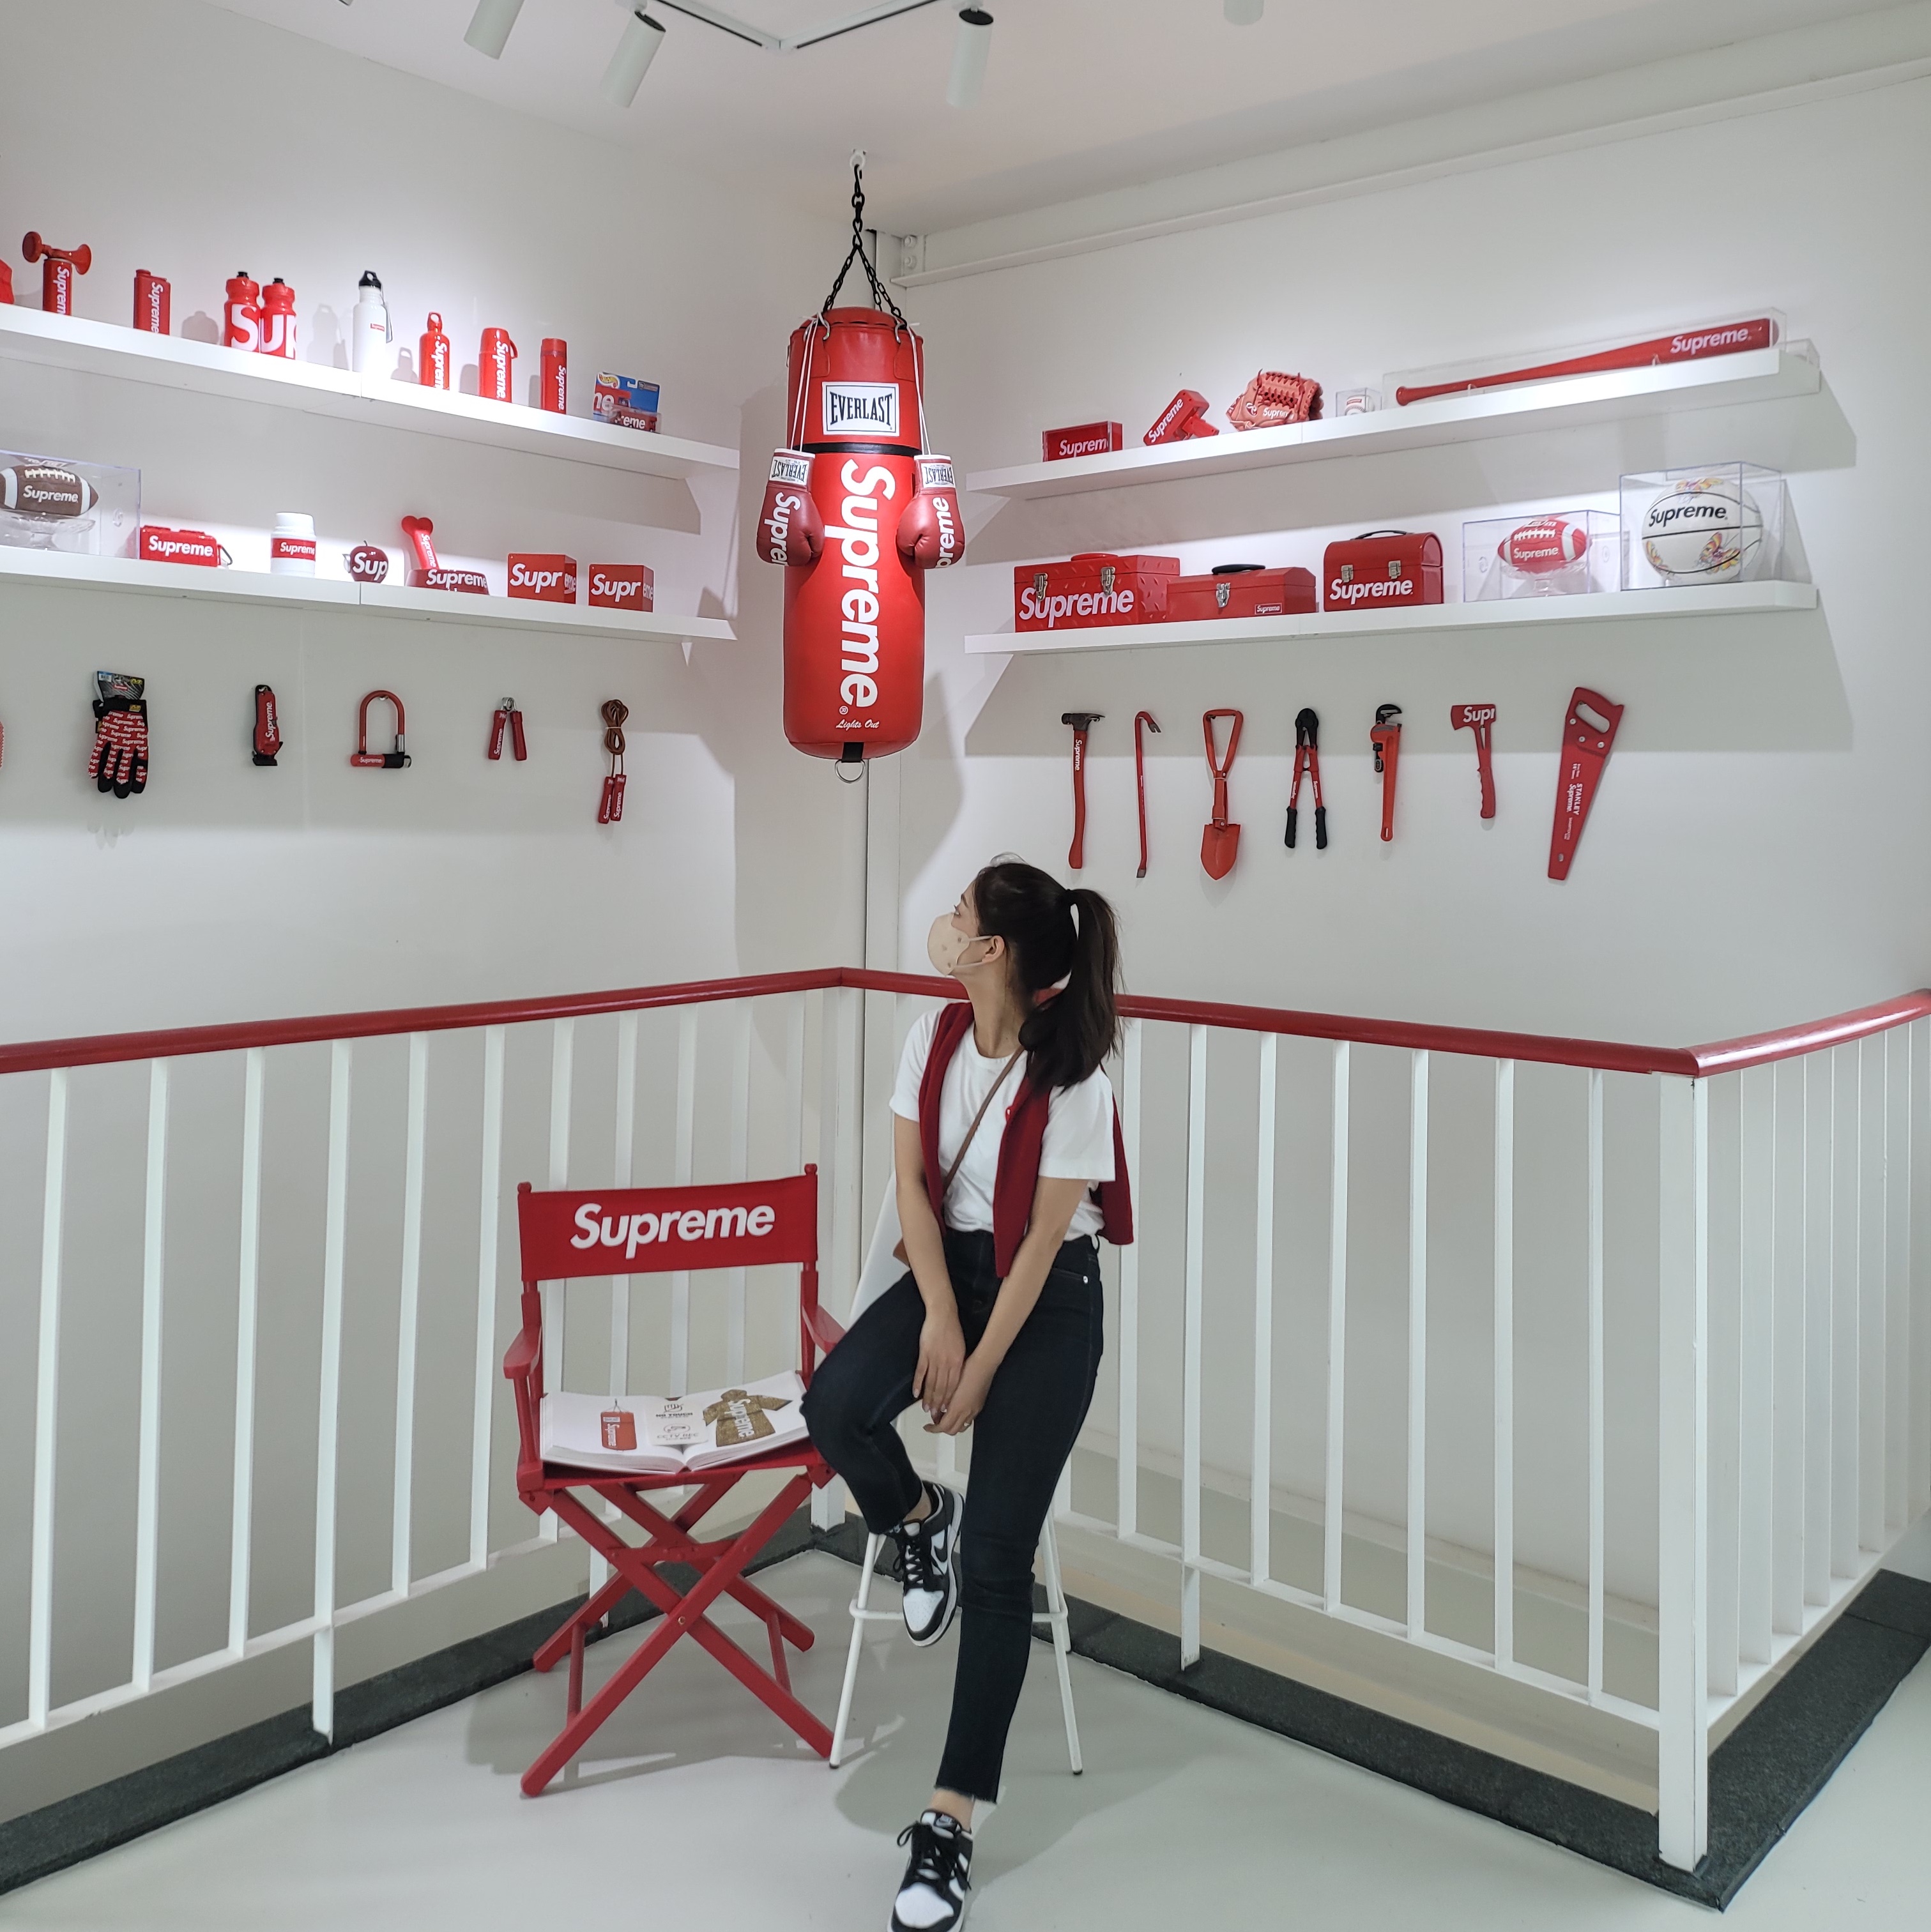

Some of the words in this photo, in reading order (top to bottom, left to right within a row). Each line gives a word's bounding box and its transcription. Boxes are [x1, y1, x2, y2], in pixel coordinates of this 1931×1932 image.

[1670, 328, 1749, 355] Supreme
[492, 340, 508, 399] Supreme
[556, 365, 566, 411] Supreme
[829, 391, 892, 427] EVERLAST
[1149, 398, 1184, 443] Supreme
[772, 460, 807, 483] EVERLAST
[924, 466, 954, 485] EVERLAST
[23, 485, 78, 503] Supreme
[1649, 506, 1727, 528] Supreme
[148, 535, 213, 557] Supreme
[421, 533, 436, 568] Supreme
[1514, 547, 1559, 561] Supreme
[426, 569, 487, 588] Supreme
[824, 458, 896, 708] Supreme
[1330, 579, 1413, 605] Supreme
[1019, 587, 1134, 628] Supreme
[1256, 605, 1280, 614] Supreme
[265, 702, 276, 742] Supreme
[835, 719, 862, 731] Lights
[864, 719, 880, 729] Out
[494, 728, 503, 755] Supreme
[1074, 738, 1083, 771] Supreme
[614, 792, 622, 818] Supreme
[1566, 784, 1576, 813] Supreme
[1573, 783, 1583, 815] STANLEY
[570, 1203, 775, 1259] Supreme
